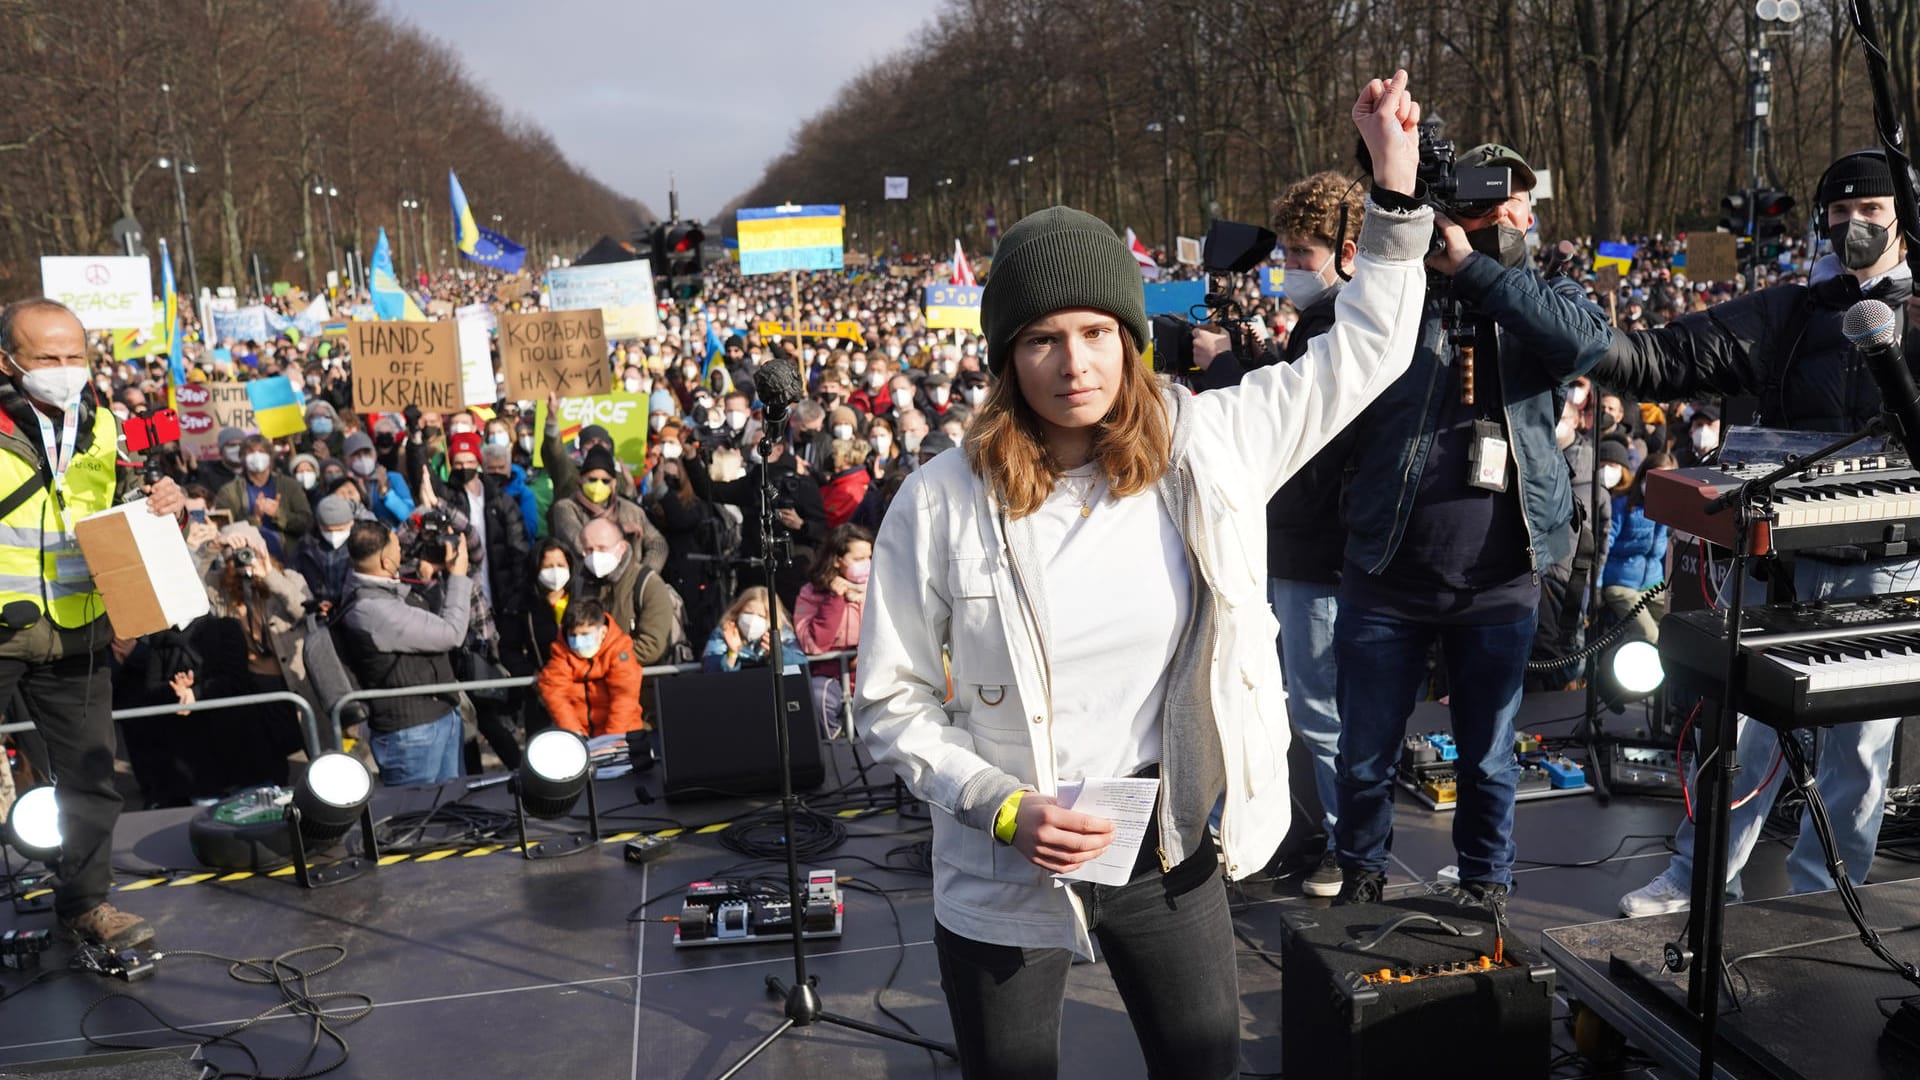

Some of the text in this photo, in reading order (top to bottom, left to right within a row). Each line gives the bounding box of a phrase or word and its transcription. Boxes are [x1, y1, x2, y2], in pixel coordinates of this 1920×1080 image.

[59, 291, 139, 311] PEACE
[934, 287, 978, 305] STOP
[359, 326, 434, 357] HANDS
[506, 318, 602, 347] КОРАБЛЬ
[520, 343, 592, 362] ПОШЕЛ
[390, 361, 425, 377] OFF
[520, 370, 549, 390] НА
[358, 377, 455, 409] UKRAINE
[214, 409, 258, 428] WAR
[559, 396, 637, 430] EACE
